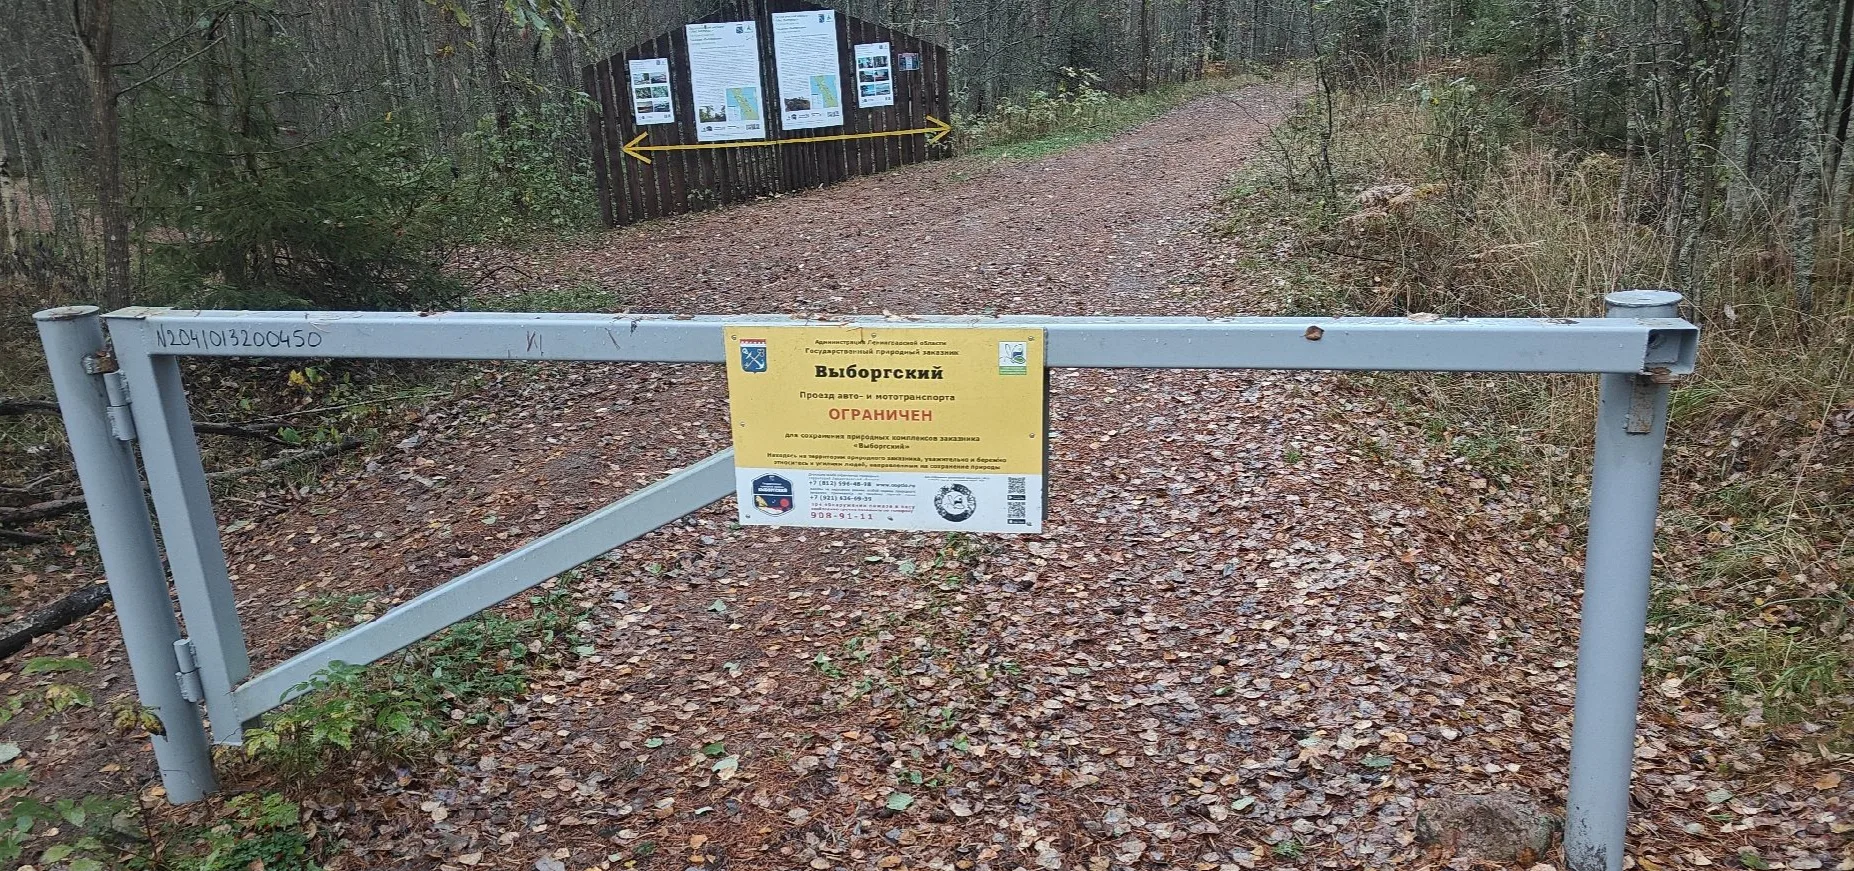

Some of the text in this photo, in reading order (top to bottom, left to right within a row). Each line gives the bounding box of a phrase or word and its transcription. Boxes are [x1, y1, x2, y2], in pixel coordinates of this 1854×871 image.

[805, 347, 874, 355] Государственный
[875, 348, 920, 356] природный
[815, 364, 944, 382] Выборгский
[799, 391, 836, 401] Проезд
[875, 394, 956, 402] мототранспорта
[828, 408, 933, 422] ОГРАНИЧЕН
[976, 456, 1007, 464] бережно
[810, 511, 873, 520] 908-91-11
